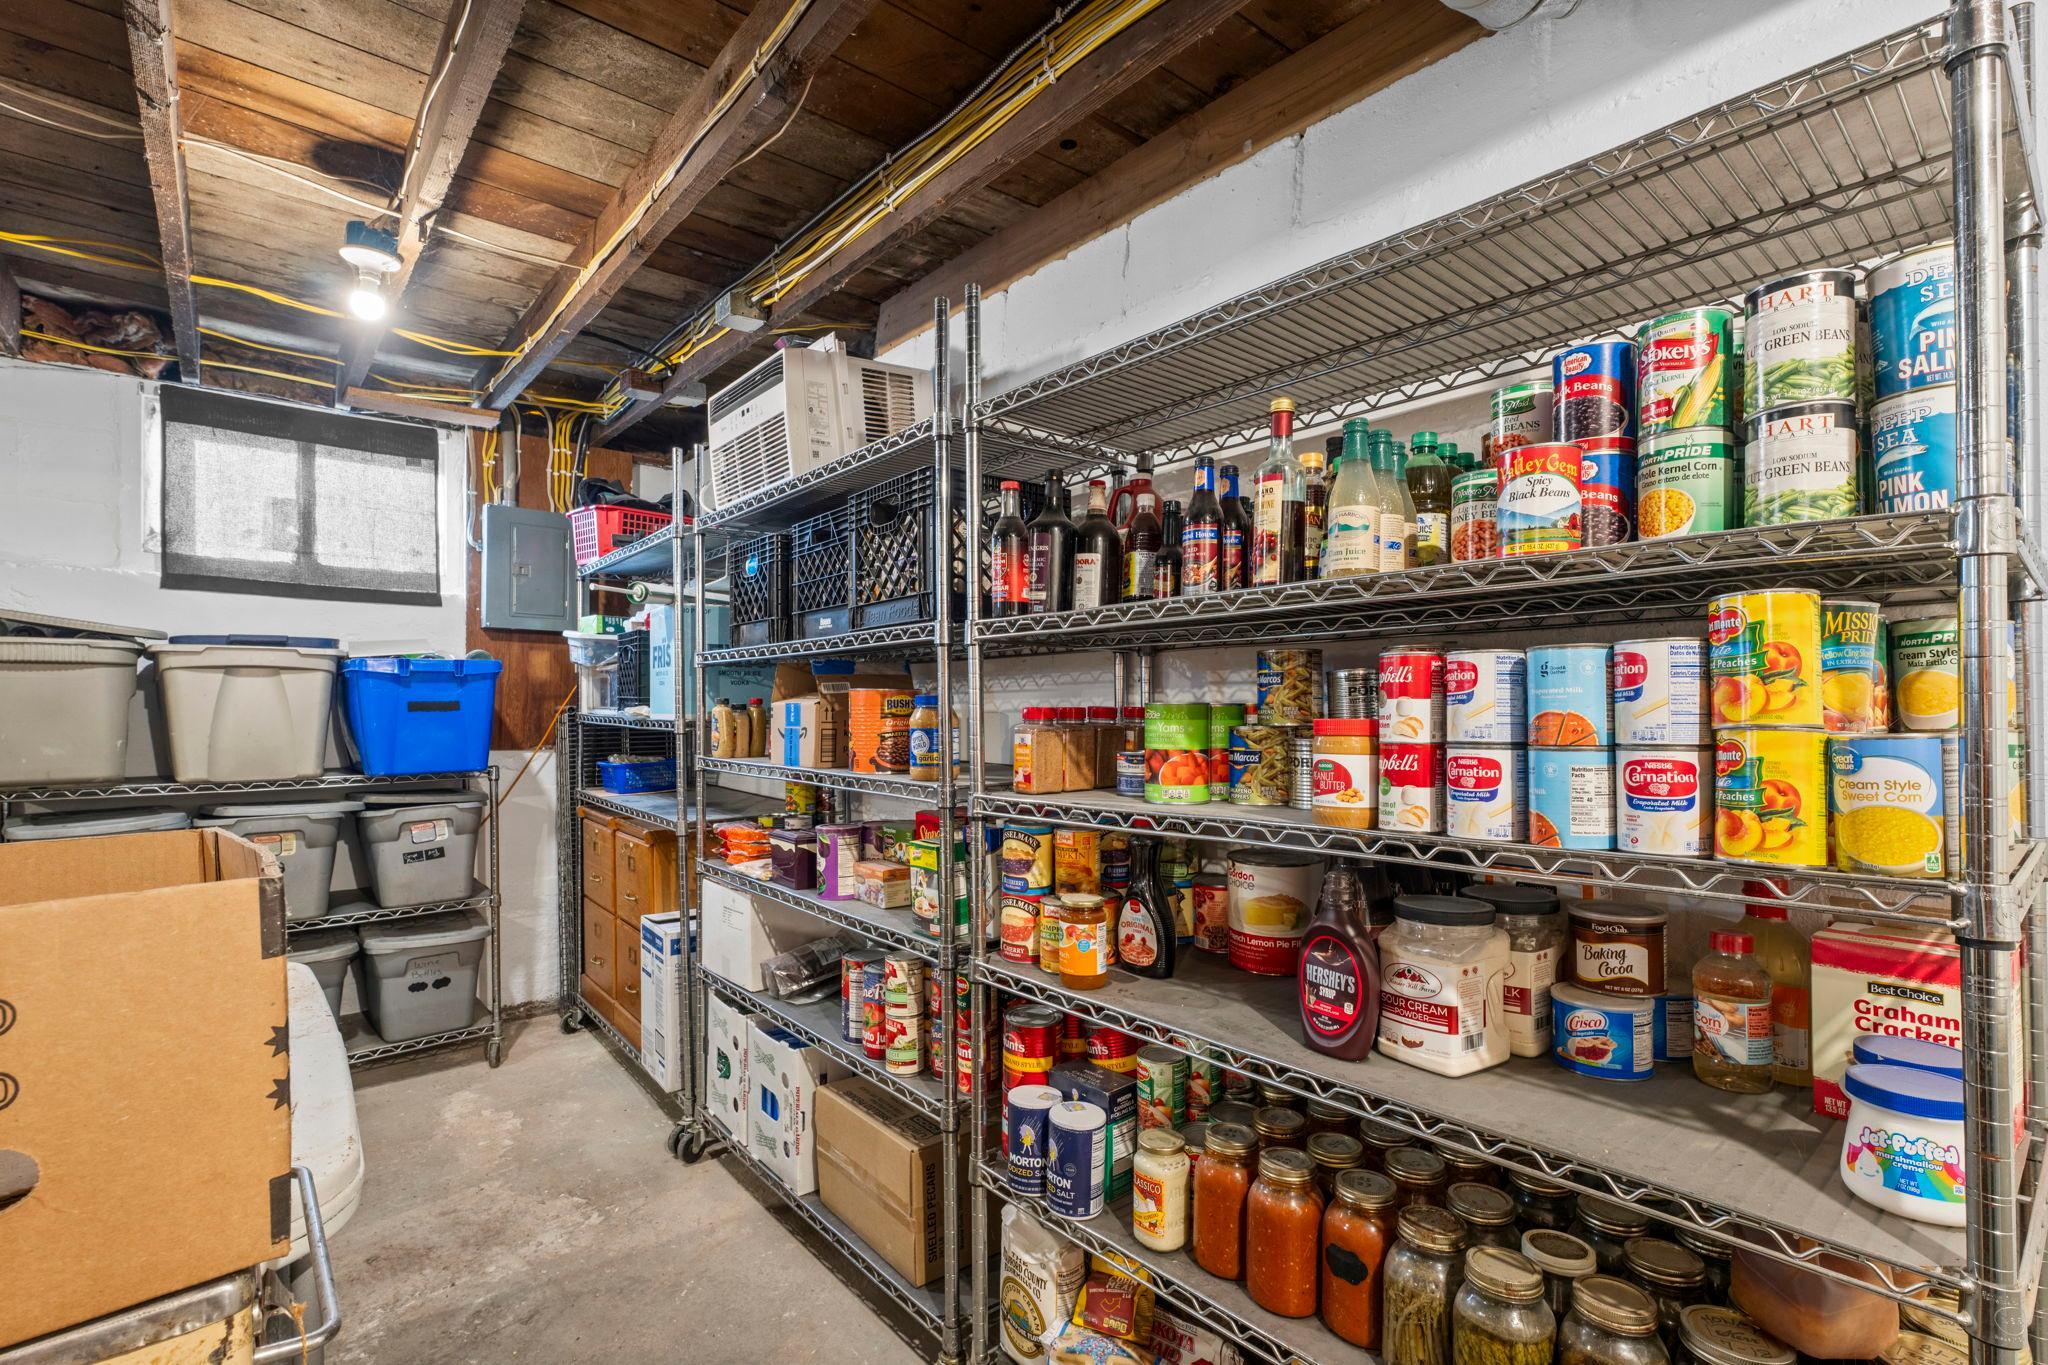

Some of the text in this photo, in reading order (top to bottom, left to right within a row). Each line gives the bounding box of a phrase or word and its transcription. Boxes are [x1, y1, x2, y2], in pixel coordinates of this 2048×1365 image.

[1905, 263, 1954, 288] DE
[1760, 283, 1833, 311] HART
[1920, 282, 1954, 303] SE
[1772, 325, 1788, 335] LOW
[1764, 330, 1812, 352] GREEN
[1815, 328, 1851, 342] BEANS
[1574, 380, 1613, 393] Beans
[1504, 415, 1519, 425] Red
[1504, 420, 1541, 433] BEANS
[1871, 406, 1932, 436] DEEP
[1877, 428, 1919, 451] SEA
[1664, 445, 1712, 462] PRIDE
[1772, 452, 1817, 465] LOW SODIUM
[1500, 453, 1578, 483] Valley Gem
[1658, 462, 1691, 476] Kernel
[1693, 461, 1717, 472] Corn
[1764, 462, 1812, 480] GREEN
[1815, 460, 1851, 473] BEANS
[1525, 475, 1553, 488] Spicy
[1681, 473, 1690, 481] de
[1692, 472, 1710, 480] elote
[1878, 471, 1925, 499] PINK
[1508, 484, 1571, 502] Black Beans
[1581, 490, 1618, 502] Beans
[1480, 501, 1497, 510] Red
[1195, 531, 1216, 540] House
[1901, 631, 1958, 648] NORTH PRI
[1899, 648, 1958, 661] Cream Style
[1717, 657, 1757, 669] Peaches
[1925, 658, 1948, 668] Estilo
[1259, 675, 1281, 684] Marcos
[1156, 722, 1185, 733] Yams
[1233, 752, 1260, 762] Marcos
[1832, 753, 1854, 764] Great
[1448, 761, 1500, 779] Carnation
[1644, 762, 1674, 770] Nestlé
[1836, 761, 1854, 770] Value
[1625, 765, 1694, 787] Carnation
[1320, 780, 1346, 791] BUTTER
[1838, 779, 1922, 793] Cream Style
[1632, 798, 1670, 807] Evaporated
[1718, 791, 1755, 802] Peaches
[1842, 790, 1923, 803] Sweet Corn
[1120, 920, 1154, 936] ORIGINAL
[1591, 923, 1628, 934] Food Club
[1003, 944, 1025, 955] CHERRY
[1246, 938, 1290, 949] Lemon Pie
[1582, 944, 1627, 966] Baking
[1598, 961, 1634, 978] Cocoa
[1306, 963, 1356, 994] HERSHEY'S
[1319, 985, 1336, 1000] SYRUP
[1870, 983, 1896, 996] Best
[1381, 992, 1448, 1017] SOUR CREAM
[1394, 1006, 1430, 1022] POWDER
[1695, 1010, 1721, 1029] Corn
[1853, 998, 1960, 1032] Graham
[1569, 1015, 1603, 1030] Crisco
[1854, 1015, 1961, 1048] Cracker
[1020, 1061, 1041, 1069] STYLE
[1107, 1061, 1126, 1070] STYLE
[1824, 1096, 1847, 1108] NET WT
[1825, 1105, 1847, 1117] 13.5 OZ
[1859, 1126, 1959, 1165] Jet-Puffed
[1876, 1150, 1944, 1172] marshmallow
[1892, 1161, 1925, 1174] creme
[1134, 1174, 1161, 1195] LASSICO
[1056, 1188, 1076, 1200] SALT
[926, 1162, 939, 1264] SHELLED PECANS
[1023, 1268, 1048, 1290] COUNTY
[1032, 1288, 1042, 1302] CO.
